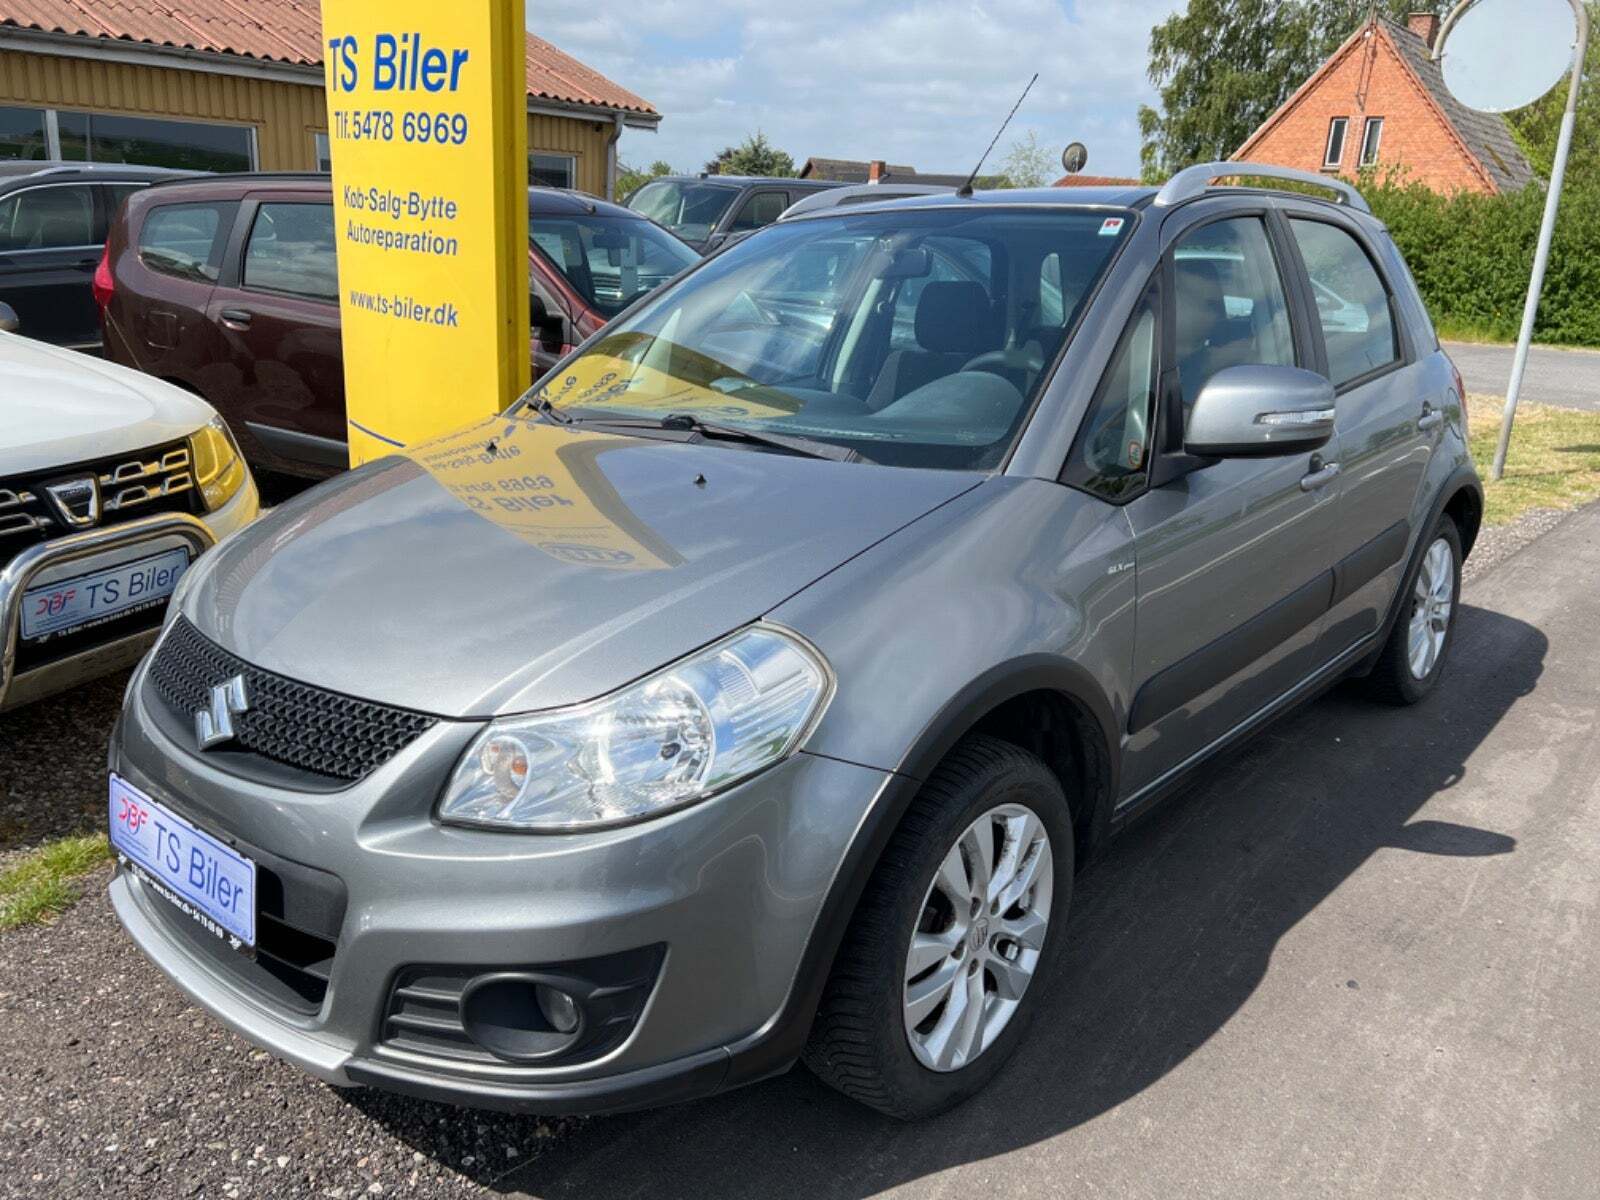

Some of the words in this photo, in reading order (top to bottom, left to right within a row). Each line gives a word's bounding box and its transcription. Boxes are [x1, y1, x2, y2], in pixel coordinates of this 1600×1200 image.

[328, 35, 359, 93] TS
[373, 32, 469, 93] Biler
[402, 111, 468, 145] 6969
[347, 219, 458, 256] Autoreparation
[350, 290, 459, 328] www.ts-biler.dk
[85, 579, 120, 609] TS
[127, 564, 180, 598] Biler
[154, 820, 182, 875] TS
[188, 845, 243, 914] Biler
